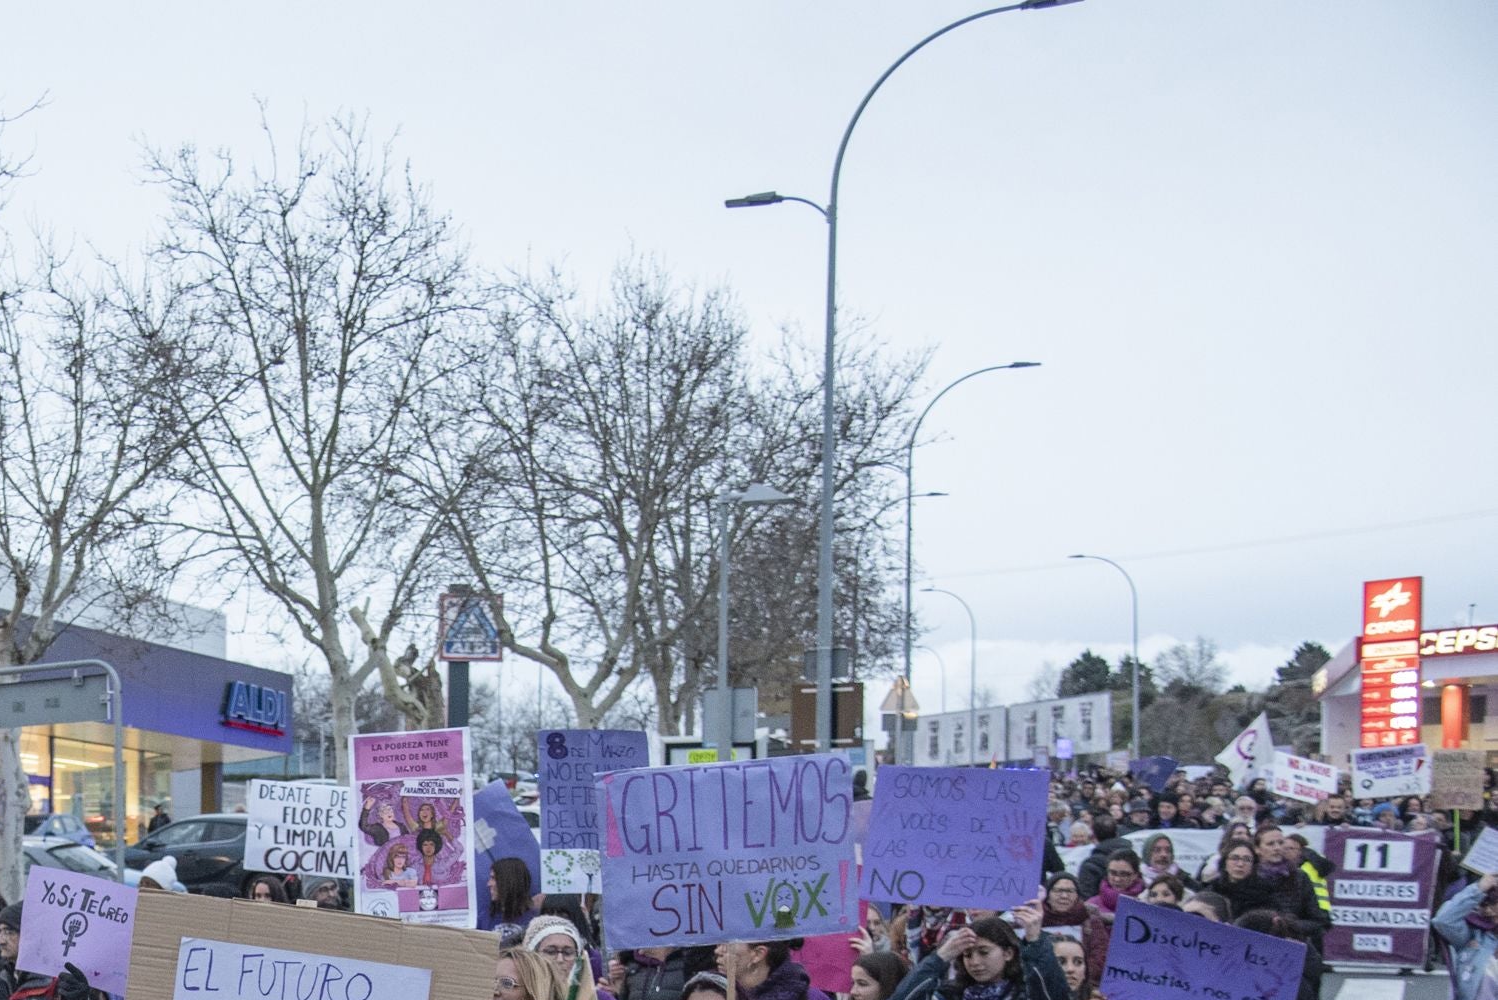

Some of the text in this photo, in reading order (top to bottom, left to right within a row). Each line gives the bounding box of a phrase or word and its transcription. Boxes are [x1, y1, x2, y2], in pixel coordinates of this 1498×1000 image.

[1420, 627, 1498, 656] CEPS
[228, 680, 287, 728] ALDI
[371, 739, 449, 752] LA POBREZA TIENE
[546, 732, 568, 760] 8
[372, 751, 449, 763] ROSTRO DE MUJER
[395, 765, 427, 774] MAYOR
[547, 762, 571, 781] NO
[576, 762, 594, 782] ES
[547, 787, 597, 806] DE FIE
[894, 773, 1021, 803] SOMOS LAS
[330, 790, 348, 809] DE
[282, 806, 347, 829] FLORES
[547, 810, 568, 829] DE
[899, 812, 990, 834] VOCES DE
[254, 824, 265, 840] Y
[274, 825, 335, 848] LIMPIA
[548, 832, 599, 849] PROT
[871, 840, 1000, 862] LAS QUE YA
[1356, 843, 1389, 868] 11
[632, 855, 820, 884] HASTA QUEDARNOS
[869, 868, 925, 900] NO
[1340, 883, 1416, 898] MUJERES
[98, 895, 129, 924] CREO
[649, 881, 724, 937] SIN
[1332, 909, 1429, 925] SESINADAS
[1124, 916, 1269, 966] Disculpe las
[182, 948, 219, 992] EL
[1203, 986, 1231, 1000] nos
